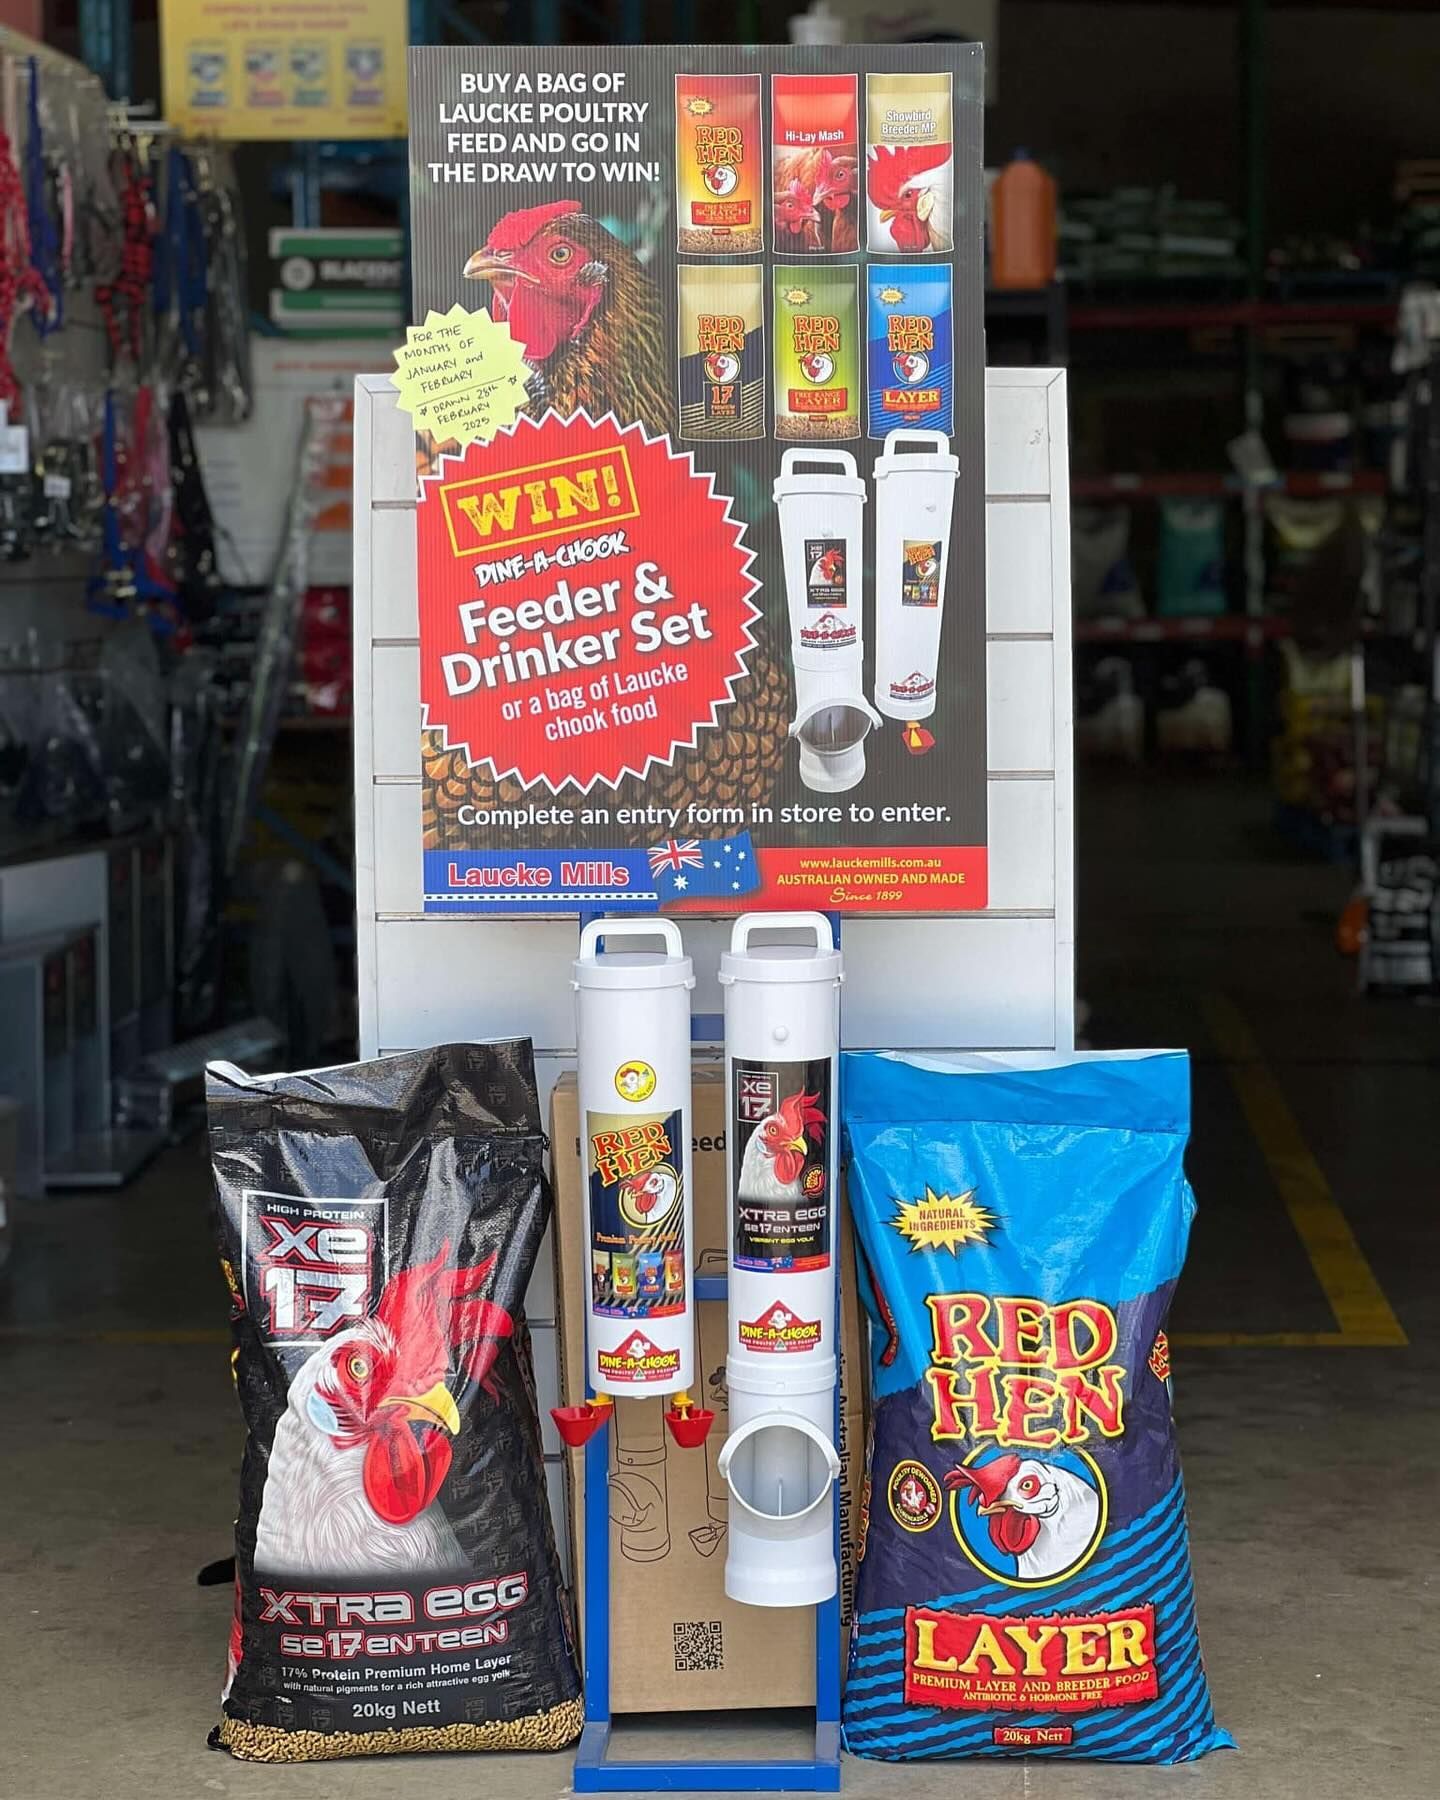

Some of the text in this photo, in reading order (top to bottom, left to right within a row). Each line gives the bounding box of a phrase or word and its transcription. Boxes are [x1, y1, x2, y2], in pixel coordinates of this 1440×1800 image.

[460, 73, 626, 93] BUY A BAG OF
[439, 102, 649, 123] LAUCKE POULTRY
[886, 110, 931, 122] Showbird
[696, 125, 742, 146] RED
[785, 129, 844, 144] Hi-Lay Mash
[882, 122, 937, 135] Breeder MP
[447, 132, 640, 153] FEED AND GO IN
[696, 144, 743, 165] HEN
[428, 162, 660, 183] THE DRAW TO WIN!
[413, 324, 461, 343] FOR THE
[698, 314, 744, 334] RED
[793, 315, 839, 335] RED
[887, 315, 933, 335] RED
[404, 337, 474, 360] MONTHS OF
[699, 332, 745, 353] HEN
[794, 333, 840, 353] HEN
[888, 333, 934, 353] HEN
[406, 358, 457, 380] JANUARY
[465, 352, 483, 364] and
[420, 369, 473, 393] FEBRUARY
[433, 394, 470, 414] DRAWN
[711, 385, 735, 405] 17
[885, 391, 939, 403] LAYER
[437, 402, 490, 425] FEBRUARY
[462, 416, 490, 431] 2025
[457, 465, 621, 536] WIN!
[474, 530, 630, 587] DINE-A-CHOOK
[458, 562, 675, 645] Feeder &
[441, 602, 713, 697] Drinker Set
[501, 662, 689, 721] or a bag of Laucke
[544, 696, 658, 742] chook food
[457, 802, 951, 829] Complete an entry form in store to enter.
[800, 857, 942, 869] www.lauckemills.com.au
[448, 861, 630, 887] Laucke Mills
[777, 873, 966, 885] AUSTRALIAN OWNED AND MADE
[829, 887, 903, 903] Since 1899
[742, 1096, 772, 1117] 17
[592, 1122, 664, 1159] RED
[597, 1135, 672, 1188] HEN
[267, 1204, 365, 1220] HIGH PROTEIN
[919, 1208, 965, 1219] NATURAL
[909, 1219, 976, 1231] INGREDIENTS
[260, 1265, 371, 1334] 17
[741, 1325, 817, 1340] DINE-A-CHOOK
[927, 1293, 1117, 1371] RED
[600, 1353, 677, 1369] DINE-A-CHOOK
[926, 1365, 1126, 1448] HEN
[913, 1619, 1149, 1676] LAYER
[281, 1653, 512, 1682] 17% Protein Premium Home Layer
[283, 1681, 301, 1690] with
[303, 1682, 334, 1693] natural
[336, 1684, 378, 1695] pigments
[381, 1682, 395, 1691] for
[406, 1680, 424, 1690] rich
[426, 1676, 469, 1688] attractive
[472, 1674, 489, 1684] egg
[492, 1669, 510, 1681] yolk
[913, 1672, 1149, 1692] PREMIUM LAYER AND BREEDER FOOD
[963, 1692, 1017, 1701] ANTIBIOTIC
[1029, 1692, 1078, 1702] HORMONE
[1081, 1691, 1103, 1700] FREE
[352, 1699, 440, 1719] 20kg Nett
[1003, 1730, 1063, 1744] 20kg Nett
